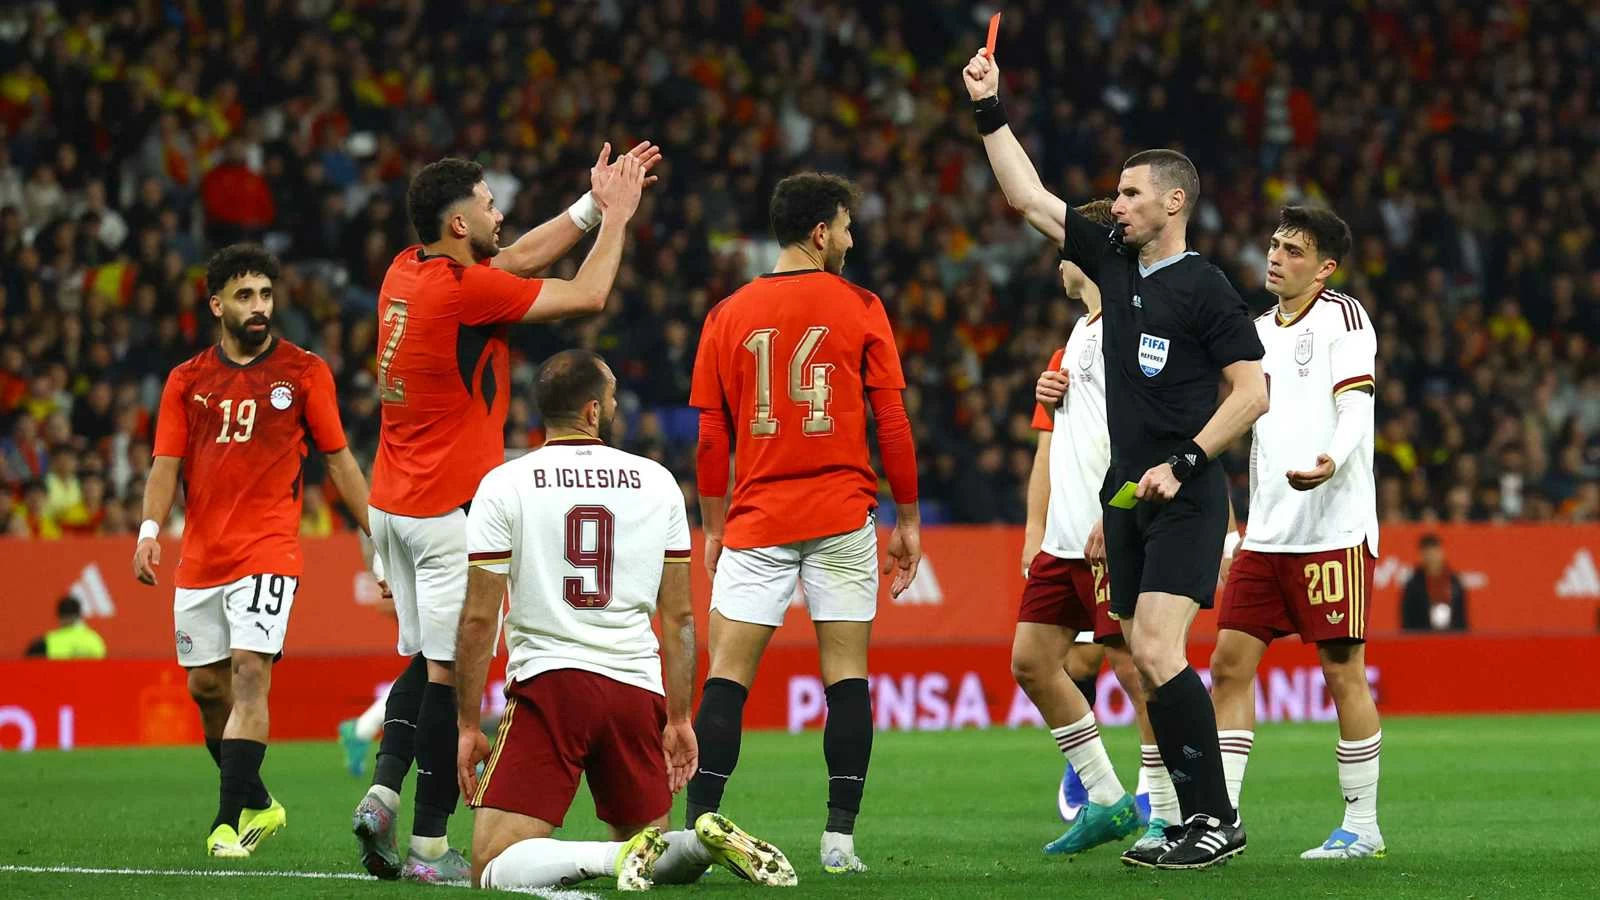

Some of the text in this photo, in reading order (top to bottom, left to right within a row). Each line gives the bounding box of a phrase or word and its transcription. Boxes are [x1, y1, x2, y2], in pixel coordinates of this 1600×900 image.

[380, 297, 408, 407] 2
[1141, 352, 1164, 363] REFEREE
[1142, 336, 1165, 351] FIFA
[743, 326, 836, 439] 14
[216, 399, 257, 443] 19
[563, 504, 615, 610] 9
[247, 573, 285, 615] 19
[1304, 560, 1344, 605] 20
[788, 671, 992, 734] PNSA
